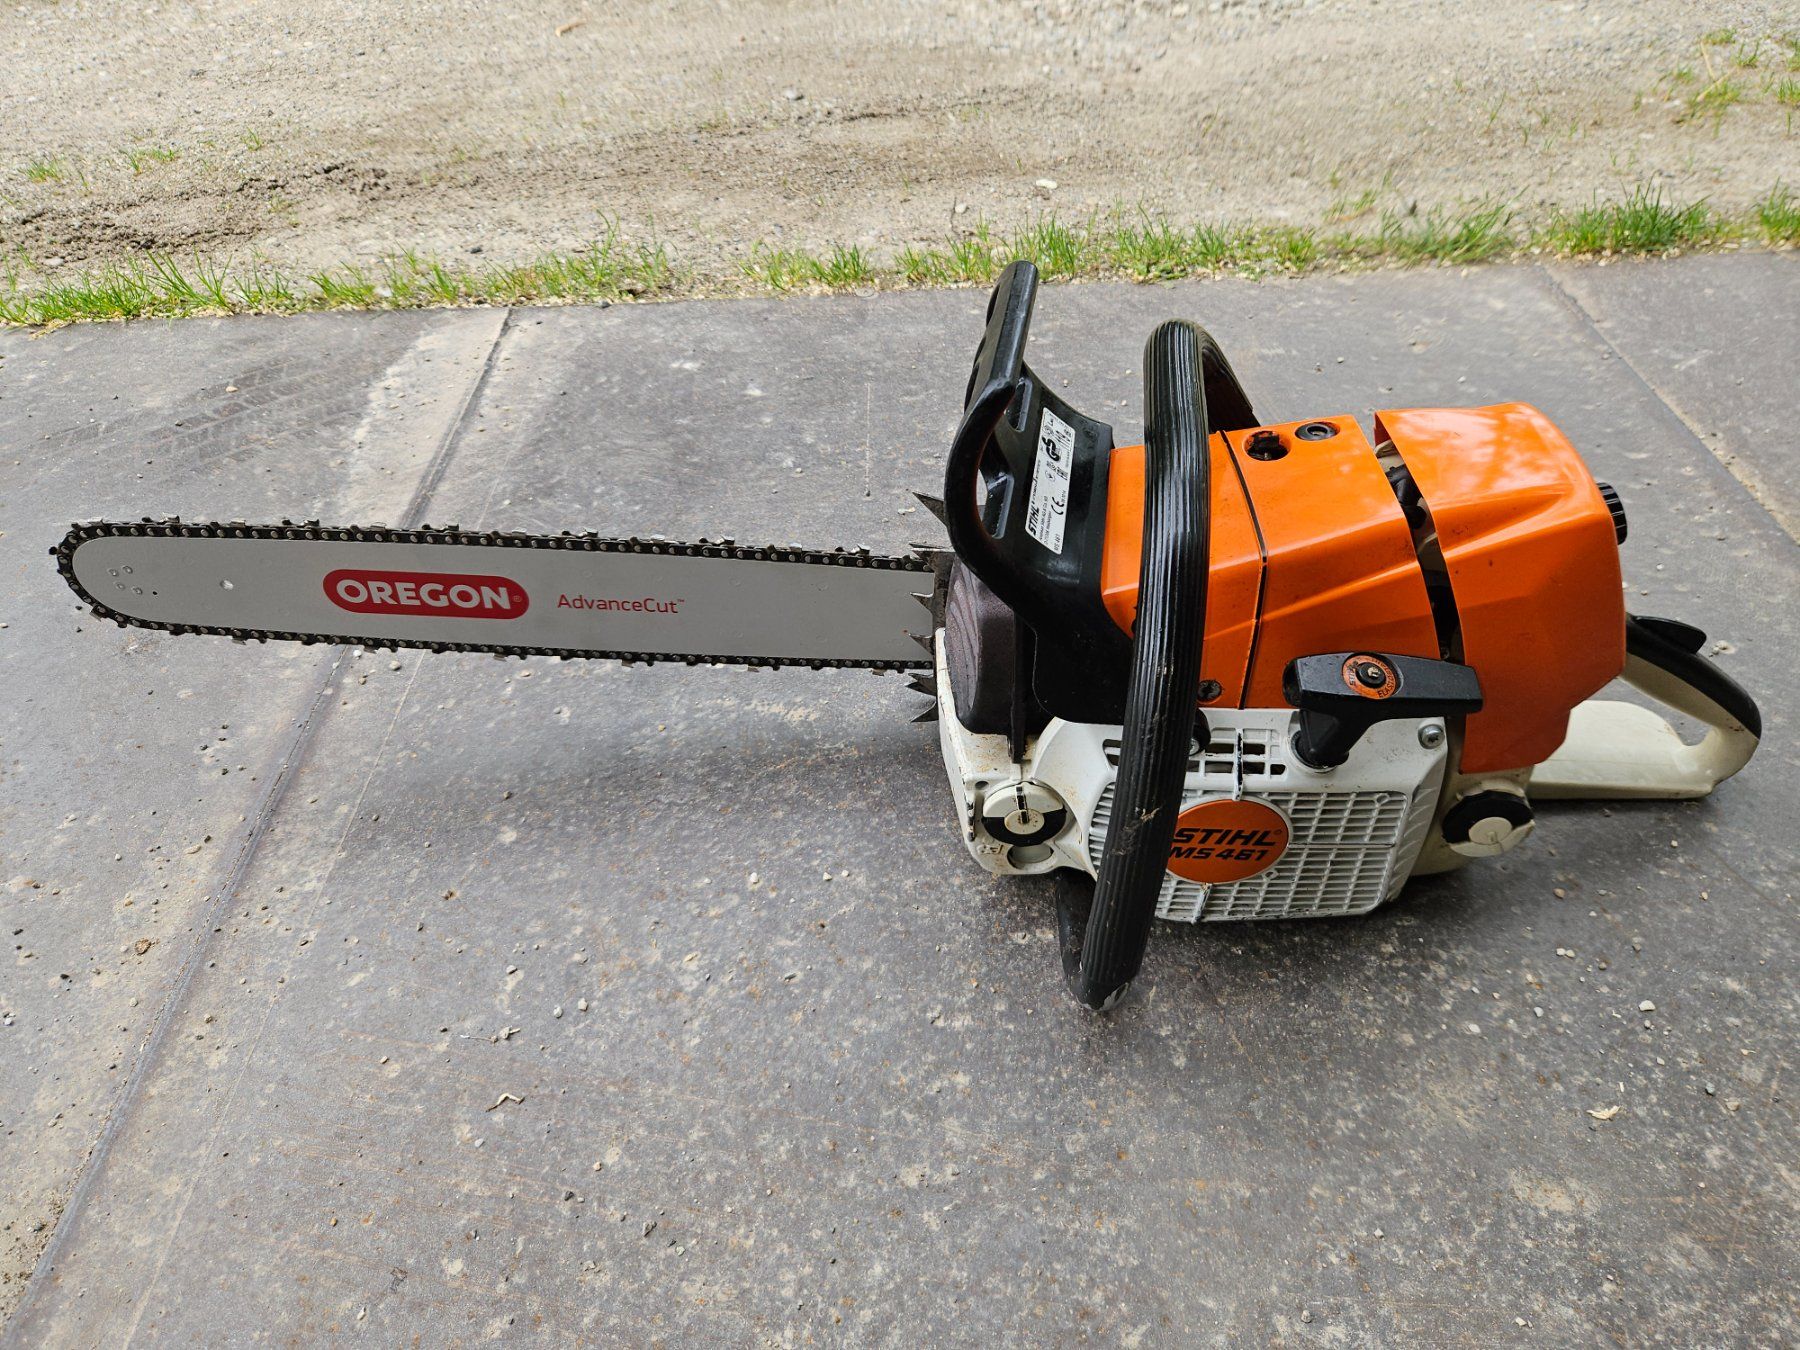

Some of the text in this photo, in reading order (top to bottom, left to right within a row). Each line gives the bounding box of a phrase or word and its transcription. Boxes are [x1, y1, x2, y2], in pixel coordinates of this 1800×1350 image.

[1028, 504, 1040, 536] STIHL
[336, 578, 511, 610] OREGON
[557, 594, 679, 614] AdvanceCut
[1170, 827, 1276, 847] STIHL
[1168, 846, 1269, 861] MS 461
